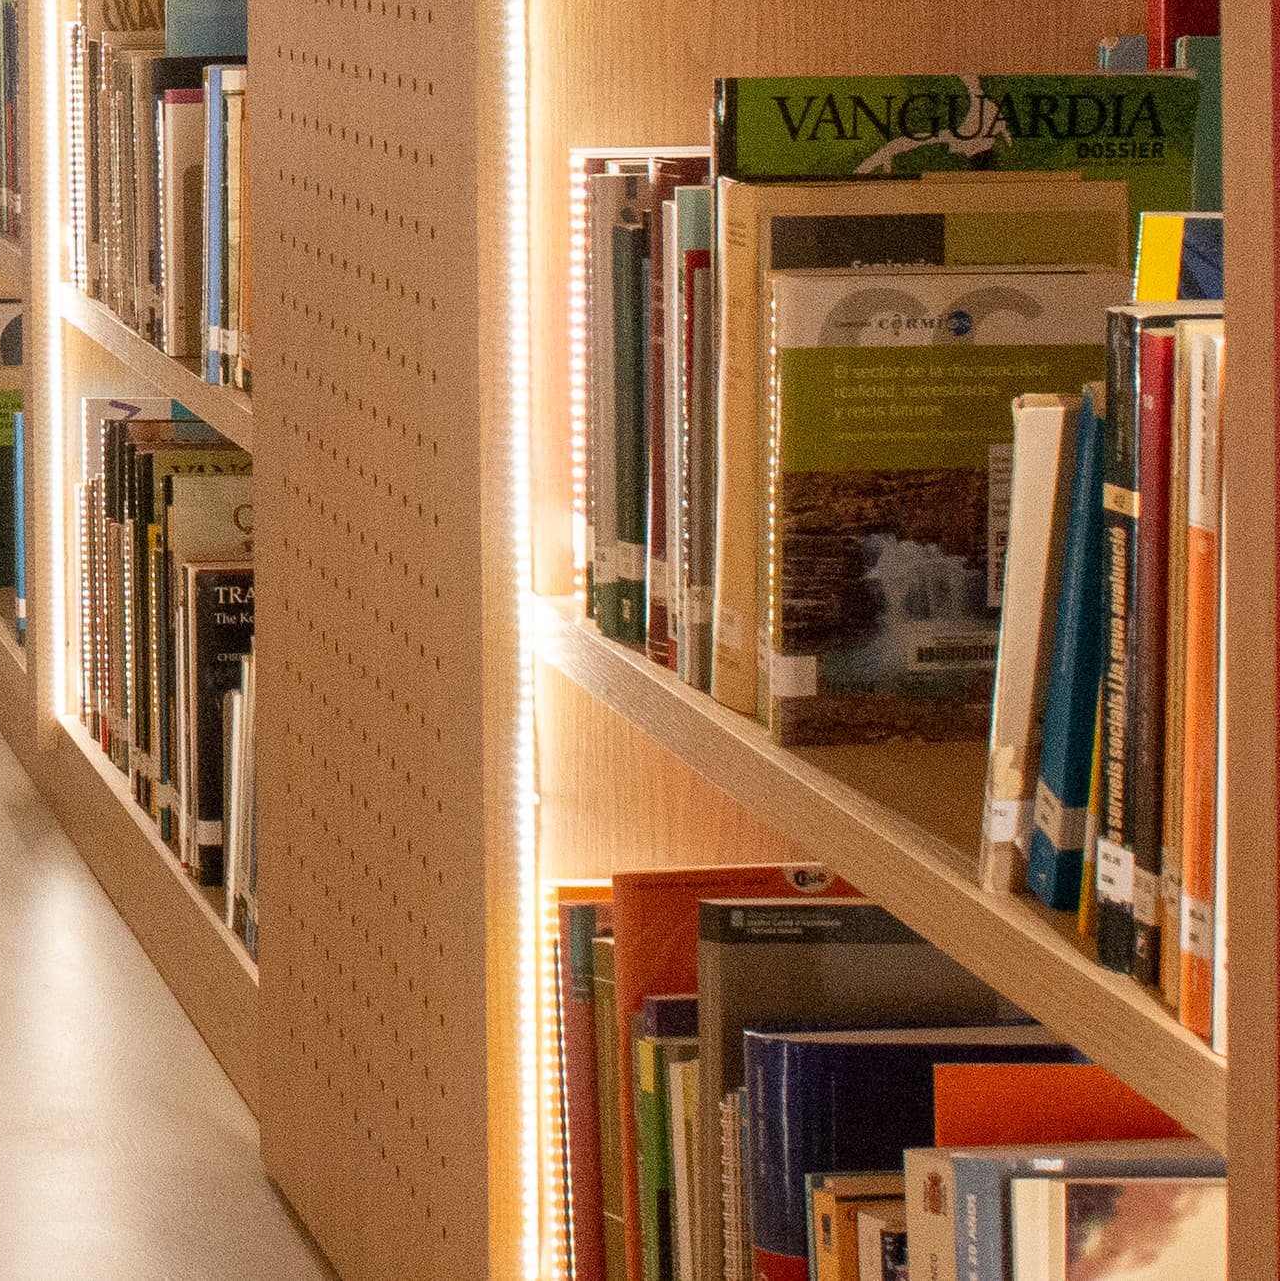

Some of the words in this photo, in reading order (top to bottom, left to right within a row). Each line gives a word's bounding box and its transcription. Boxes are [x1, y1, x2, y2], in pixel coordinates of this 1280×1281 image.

[771, 94, 1166, 141] VANGUARDIA
[1077, 142, 1165, 159] DOSSIER
[1109, 526, 1128, 615] avaluació
[213, 612, 237, 625] The
[1109, 618, 1127, 661] seva
[1108, 695, 1125, 759] socials
